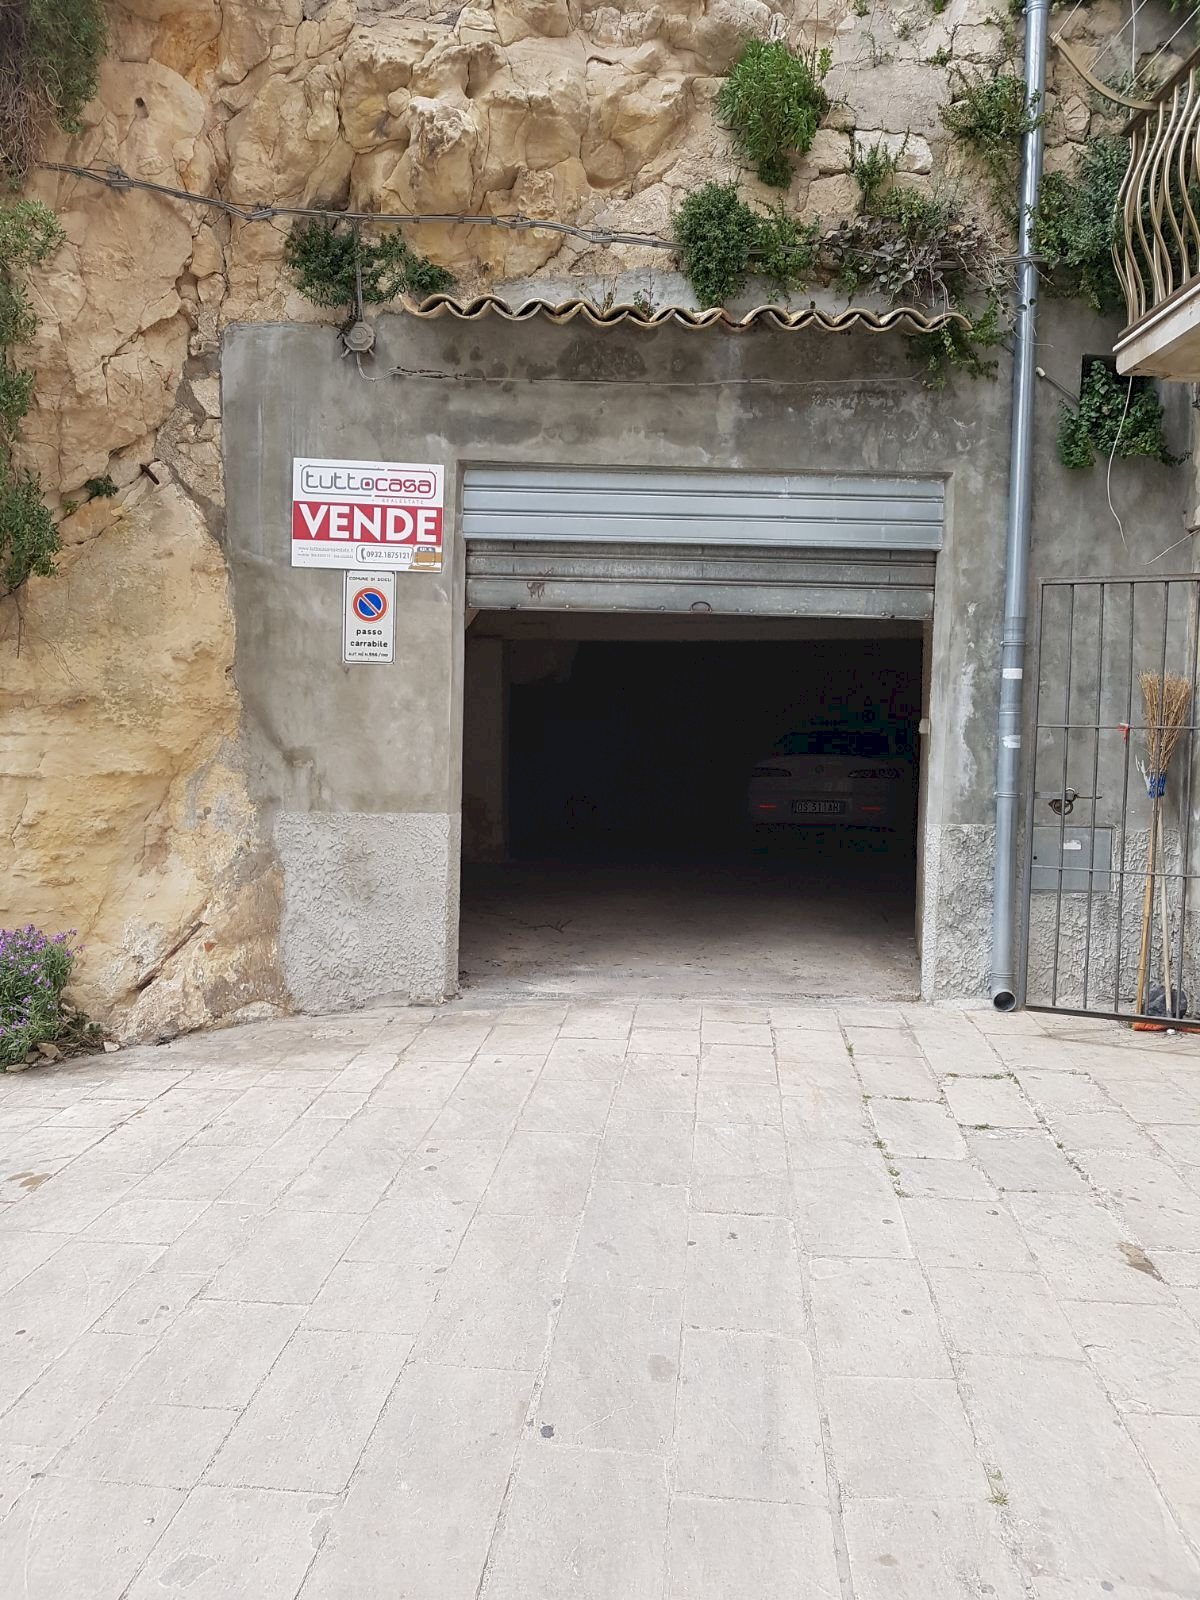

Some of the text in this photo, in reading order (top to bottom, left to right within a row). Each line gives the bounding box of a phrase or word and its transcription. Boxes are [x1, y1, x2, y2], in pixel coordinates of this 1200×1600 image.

[305, 470, 432, 494] tuttocasa
[298, 503, 437, 542] VENDE
[366, 550, 410, 560] 0932.1875121
[356, 629, 383, 637] passo
[350, 640, 388, 648] carrabile
